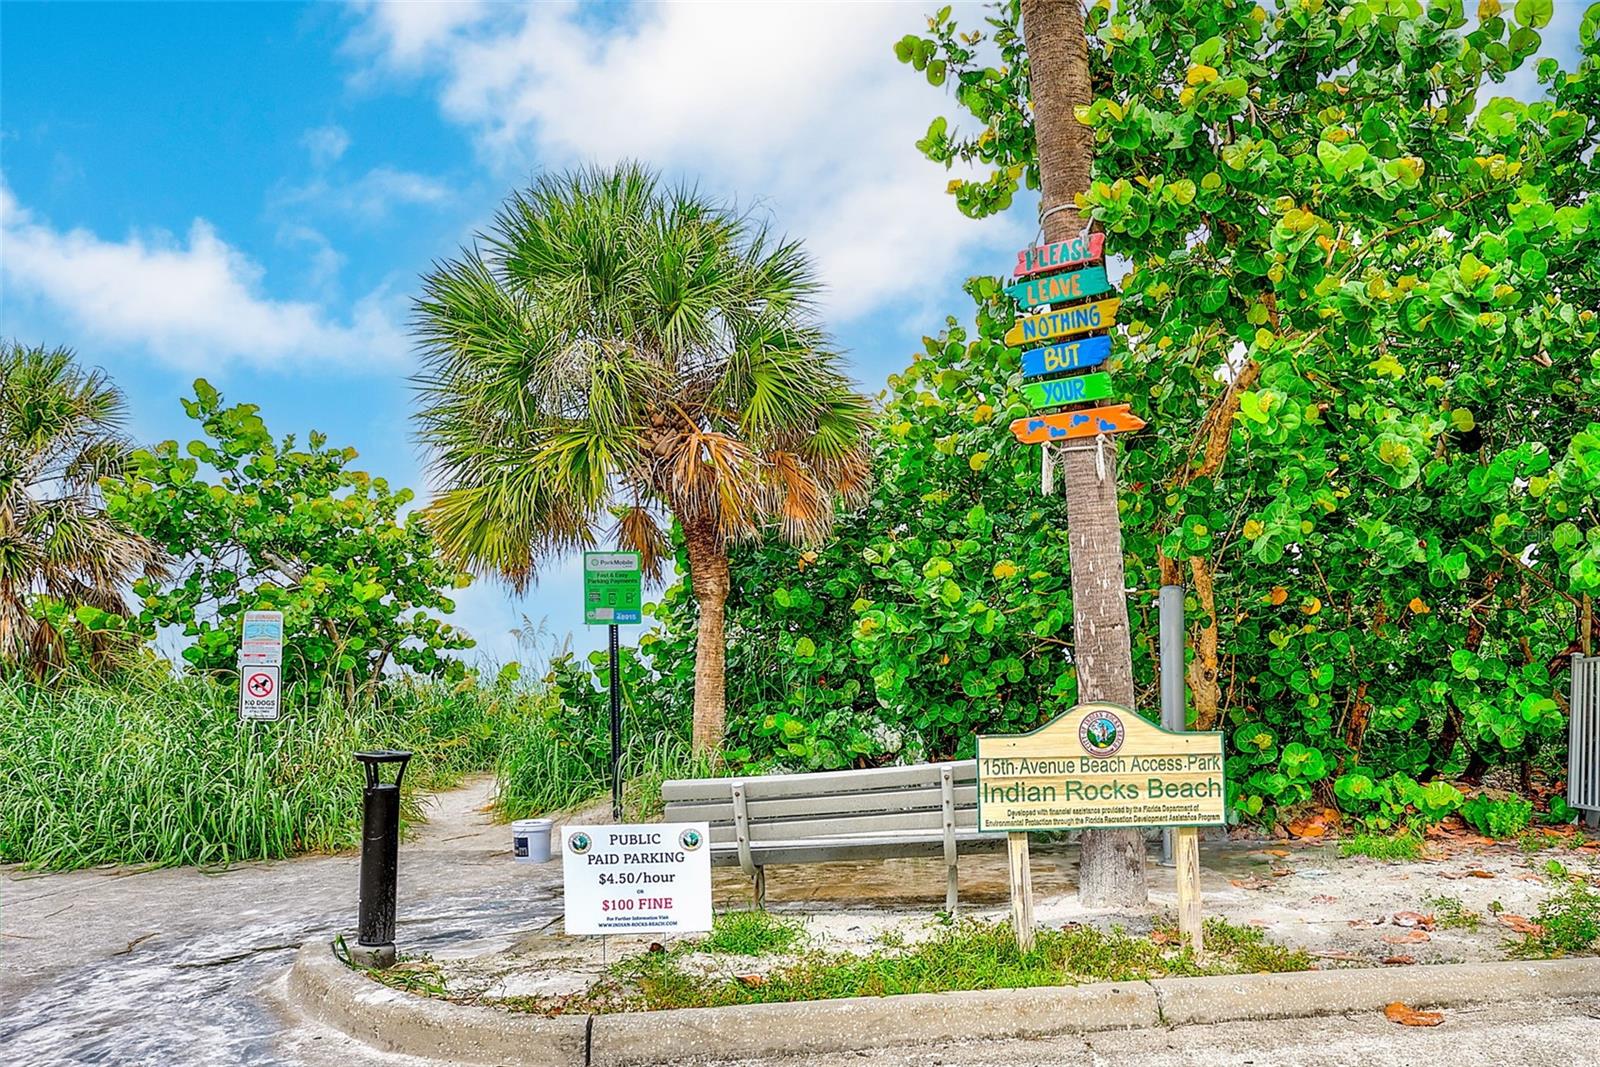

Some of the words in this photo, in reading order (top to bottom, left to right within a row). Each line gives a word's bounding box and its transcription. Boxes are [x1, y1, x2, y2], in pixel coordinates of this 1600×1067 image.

[1027, 274, 1083, 305] LEAVE
[1023, 305, 1101, 340] NOTHING
[1044, 343, 1081, 371] BUT
[1042, 378, 1086, 404] YOUR
[983, 759, 1015, 775] 15th
[1019, 758, 1075, 774] Avenue
[1080, 757, 1126, 773] Beach
[1131, 756, 1183, 772] Access
[1188, 754, 1221, 771] Park
[983, 781, 1056, 803] Indian
[1065, 780, 1139, 801] Rocks
[1148, 778, 1221, 799] Beach
[1007, 808, 1036, 817] Developed
[1072, 807, 1101, 815] assistance
[1102, 806, 1125, 815] provided
[1125, 805, 1132, 814] by
[1162, 804, 1192, 813] Department
[1193, 803, 1200, 811] of
[985, 819, 1024, 827] Environmental
[1025, 818, 1052, 826] Protection
[1053, 818, 1074, 826] through
[1085, 816, 1103, 824] Florida
[1104, 815, 1132, 823] Recreation
[1133, 814, 1168, 823] Development
[1169, 813, 1197, 821] Assistance
[1198, 812, 1220, 822] Program
[609, 833, 661, 846] PUBLIC
[587, 853, 620, 865] PAID
[623, 851, 685, 864] PARKING
[598, 871, 676, 885] $4.50/hour
[602, 899, 634, 912] $100
[638, 897, 673, 910] FINE
